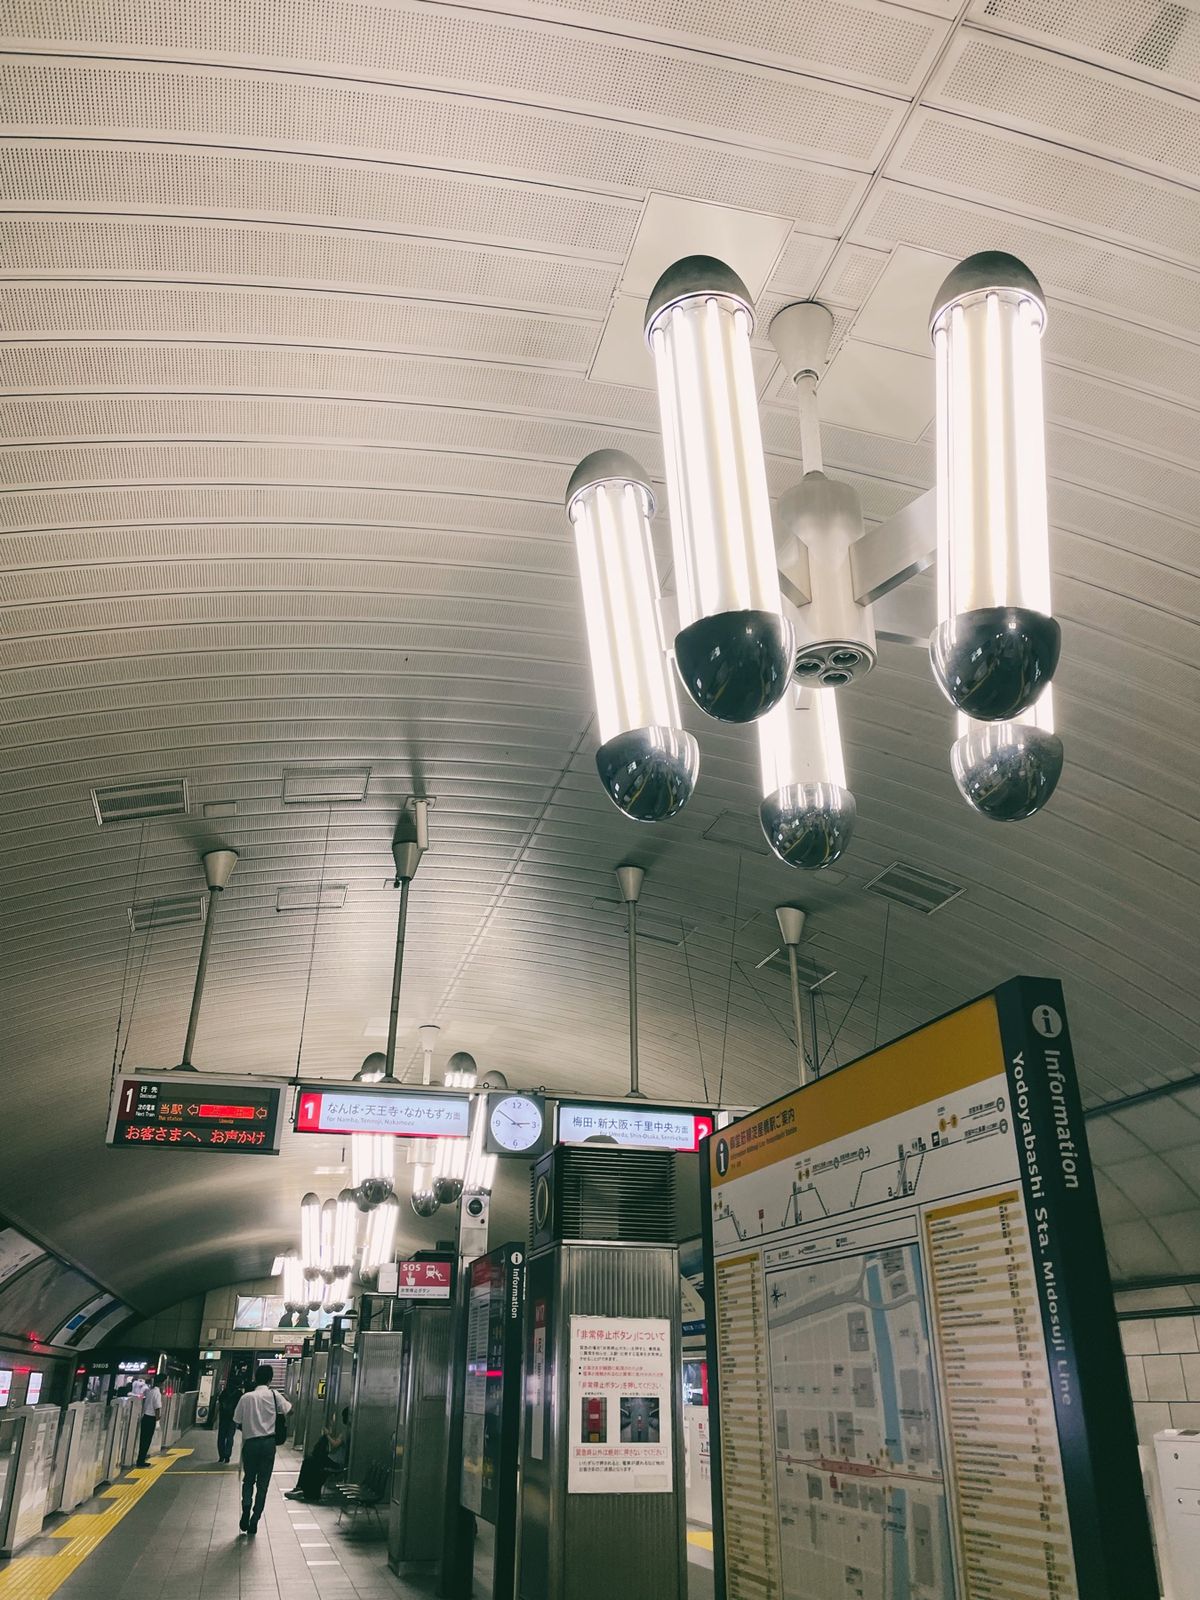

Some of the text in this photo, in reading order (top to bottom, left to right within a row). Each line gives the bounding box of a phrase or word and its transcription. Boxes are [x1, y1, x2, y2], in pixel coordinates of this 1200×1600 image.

[125, 1087, 134, 1113] 1
[160, 1103, 183, 1115] 当駅
[303, 1102, 314, 1119] 1
[1044, 1050, 1079, 1188] Information
[1012, 1051, 1071, 1406] Yodoyabashi Sta. Midosuji Line
[402, 1263, 421, 1272] SOS
[511, 1268, 520, 1319] Information
